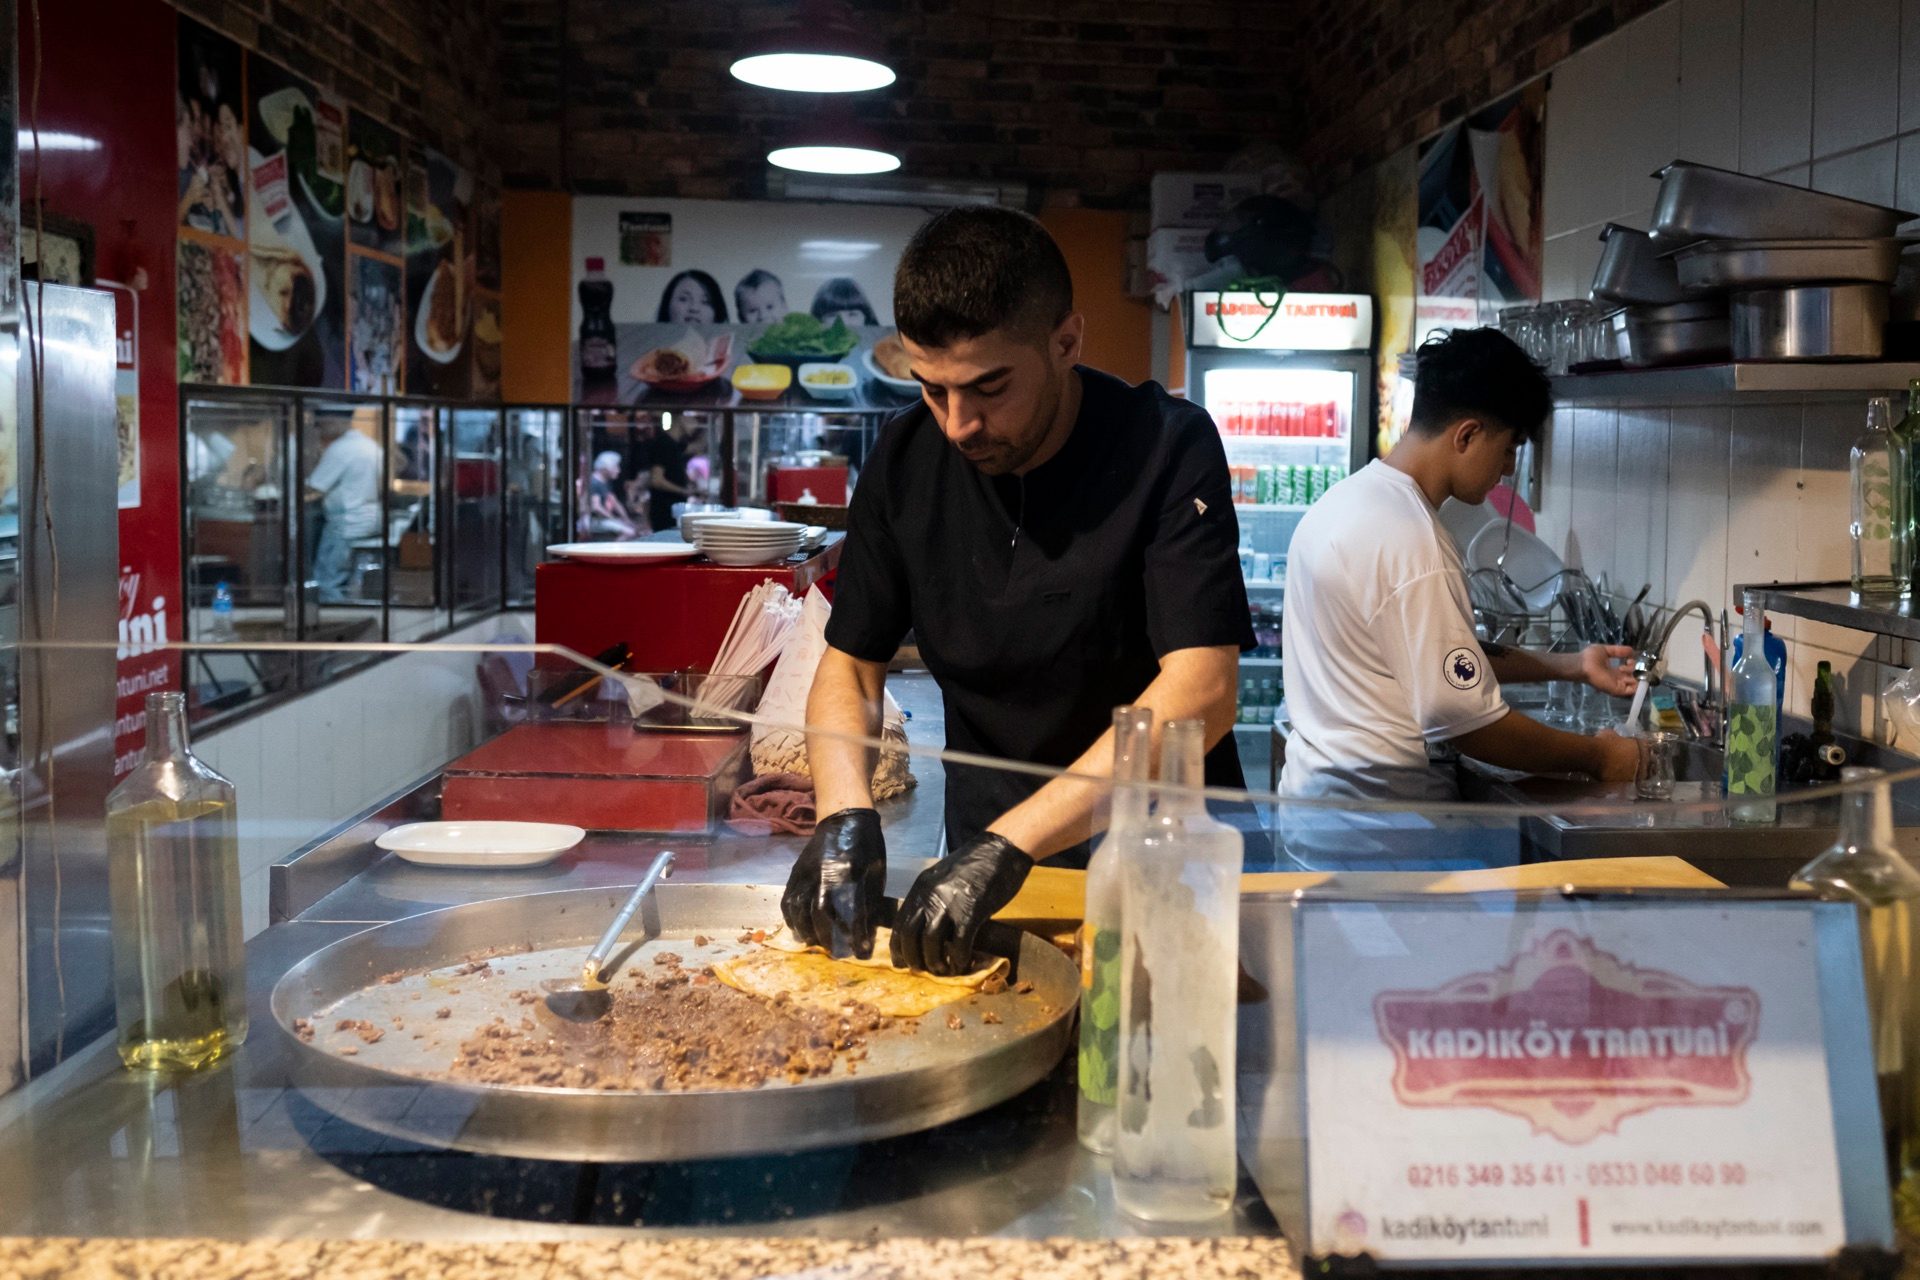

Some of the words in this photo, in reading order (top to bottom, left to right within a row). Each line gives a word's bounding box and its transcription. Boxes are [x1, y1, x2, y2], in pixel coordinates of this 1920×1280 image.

[1408, 1020, 1574, 1058] KADIKÖY
[1408, 1163, 1458, 1187] 0216
[1511, 1163, 1536, 1186] 35
[1541, 1163, 1565, 1186] 41
[1588, 1162, 1637, 1186] 0533
